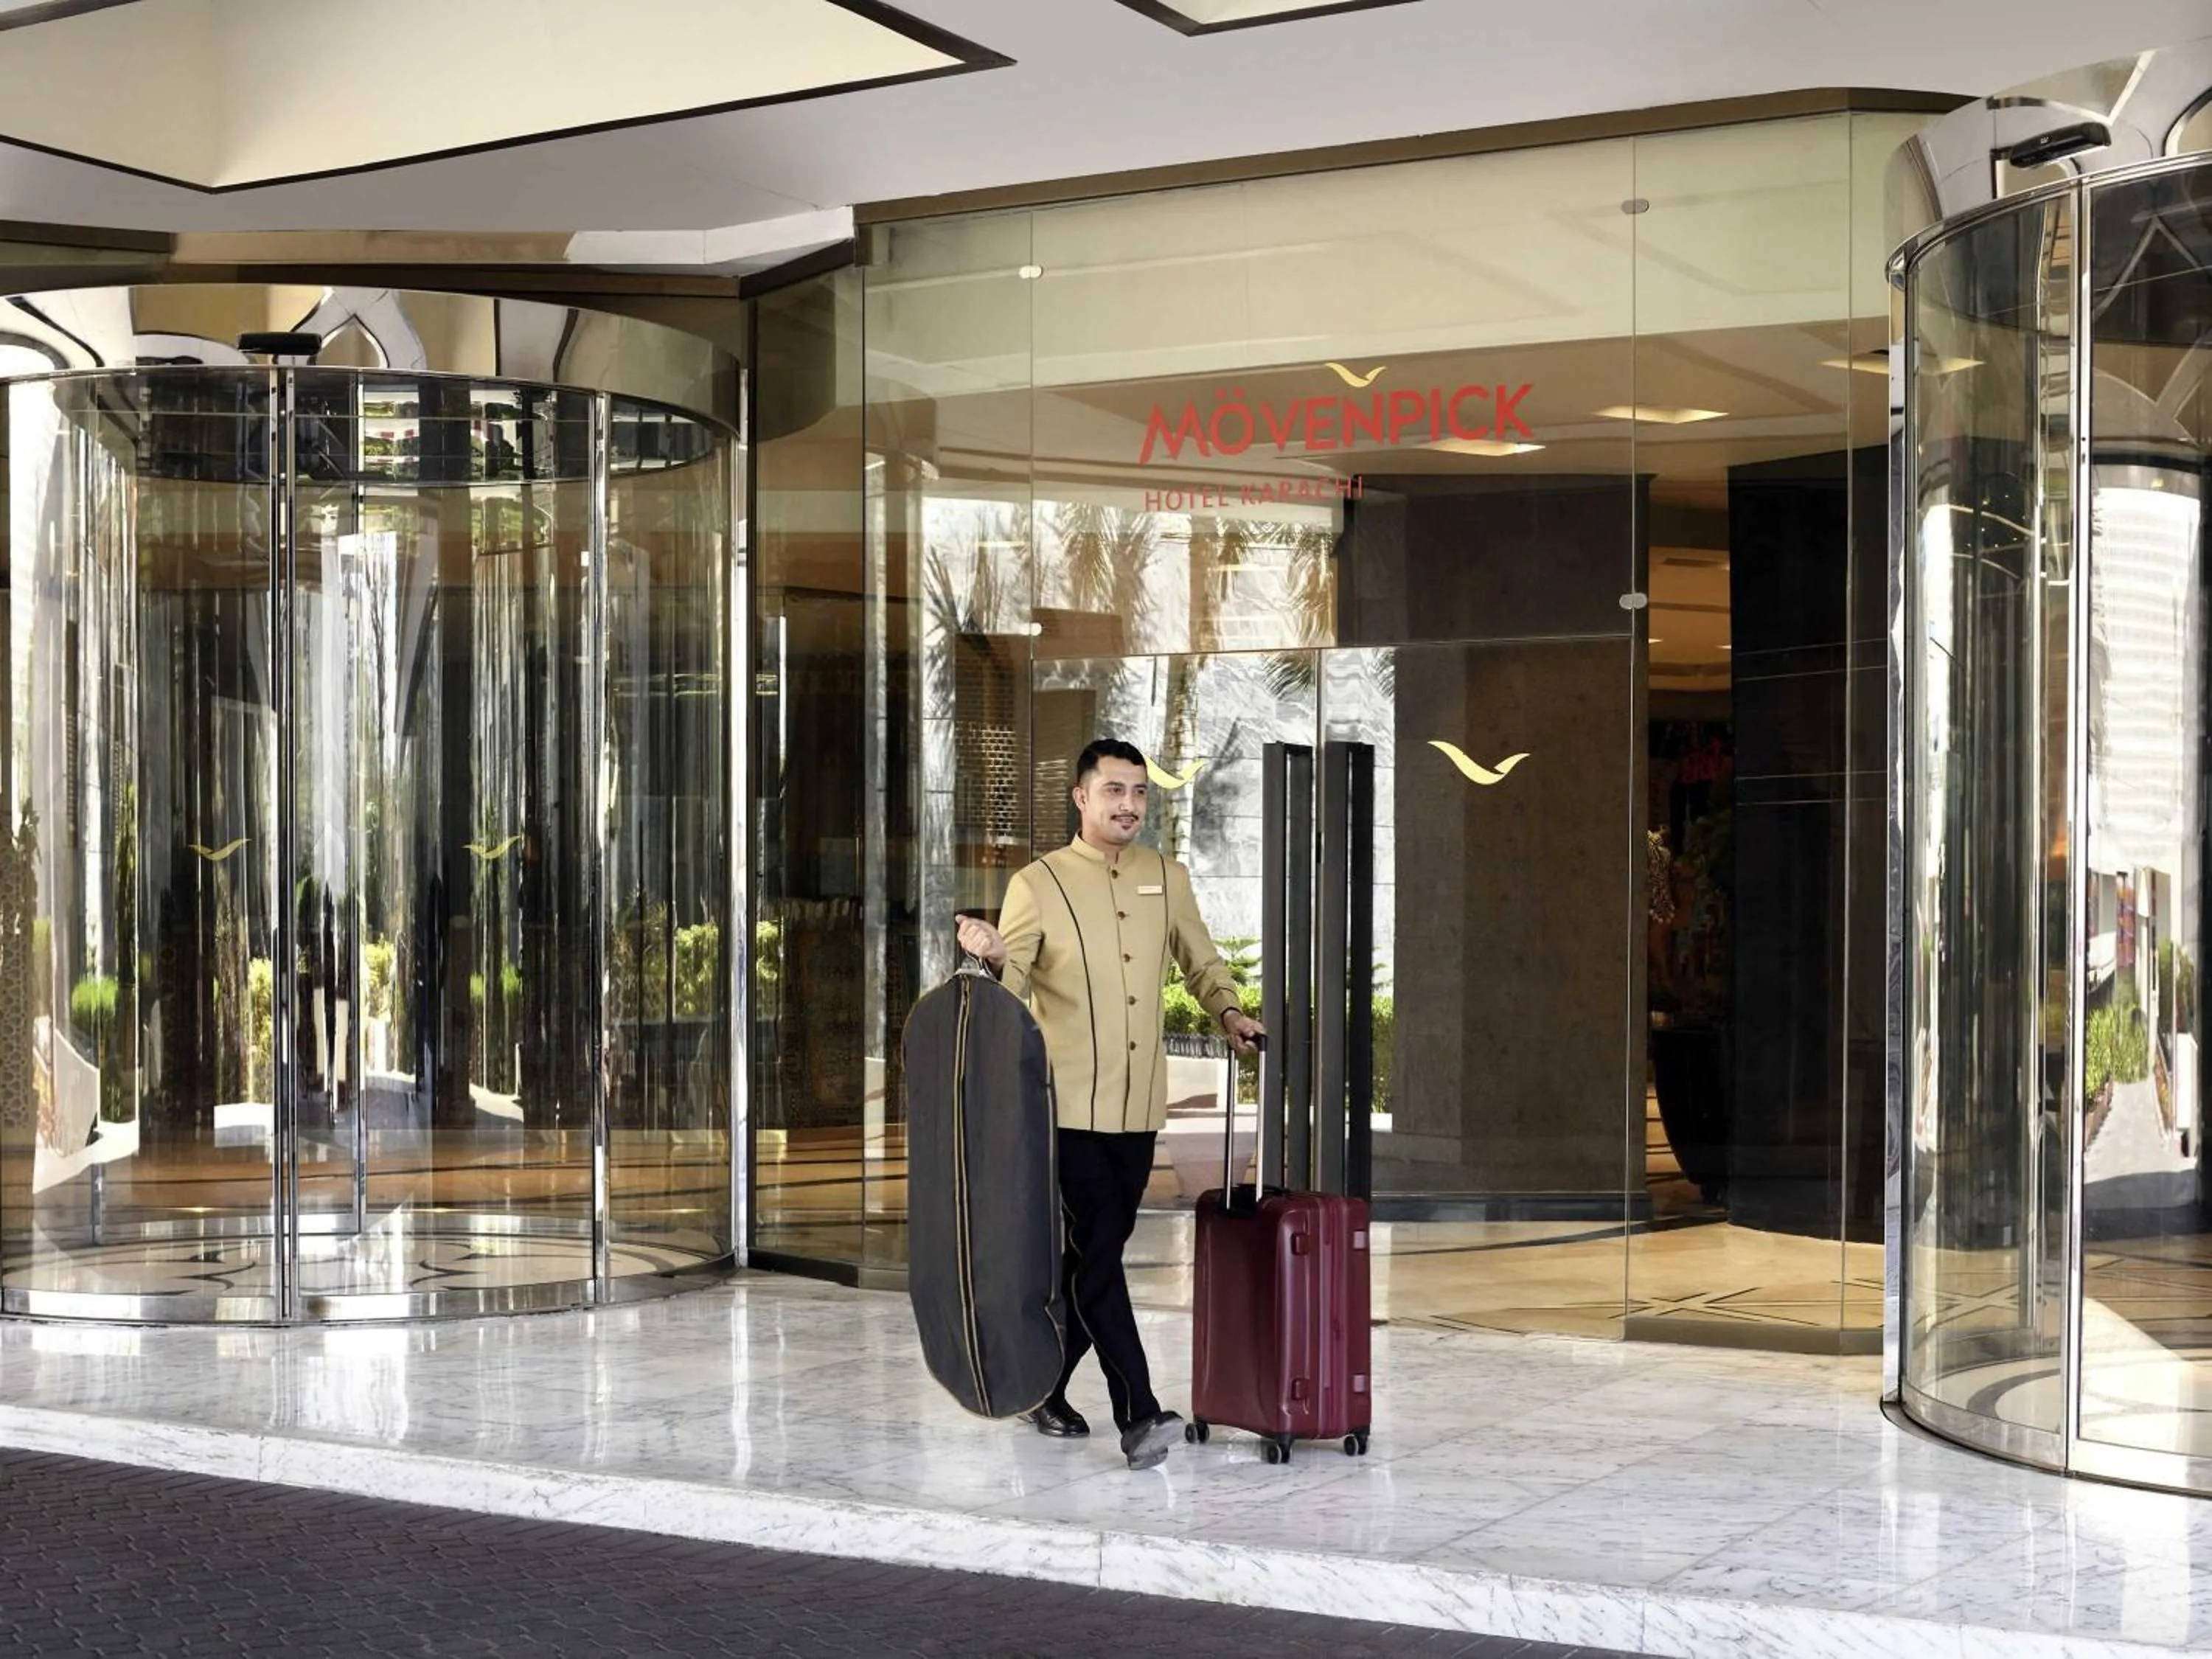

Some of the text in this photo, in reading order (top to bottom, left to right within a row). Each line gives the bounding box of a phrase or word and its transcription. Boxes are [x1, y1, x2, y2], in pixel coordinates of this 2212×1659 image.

[1139, 383, 1534, 465] MÖVENPICK
[1145, 474, 1363, 512] HOTEL KARACHI
